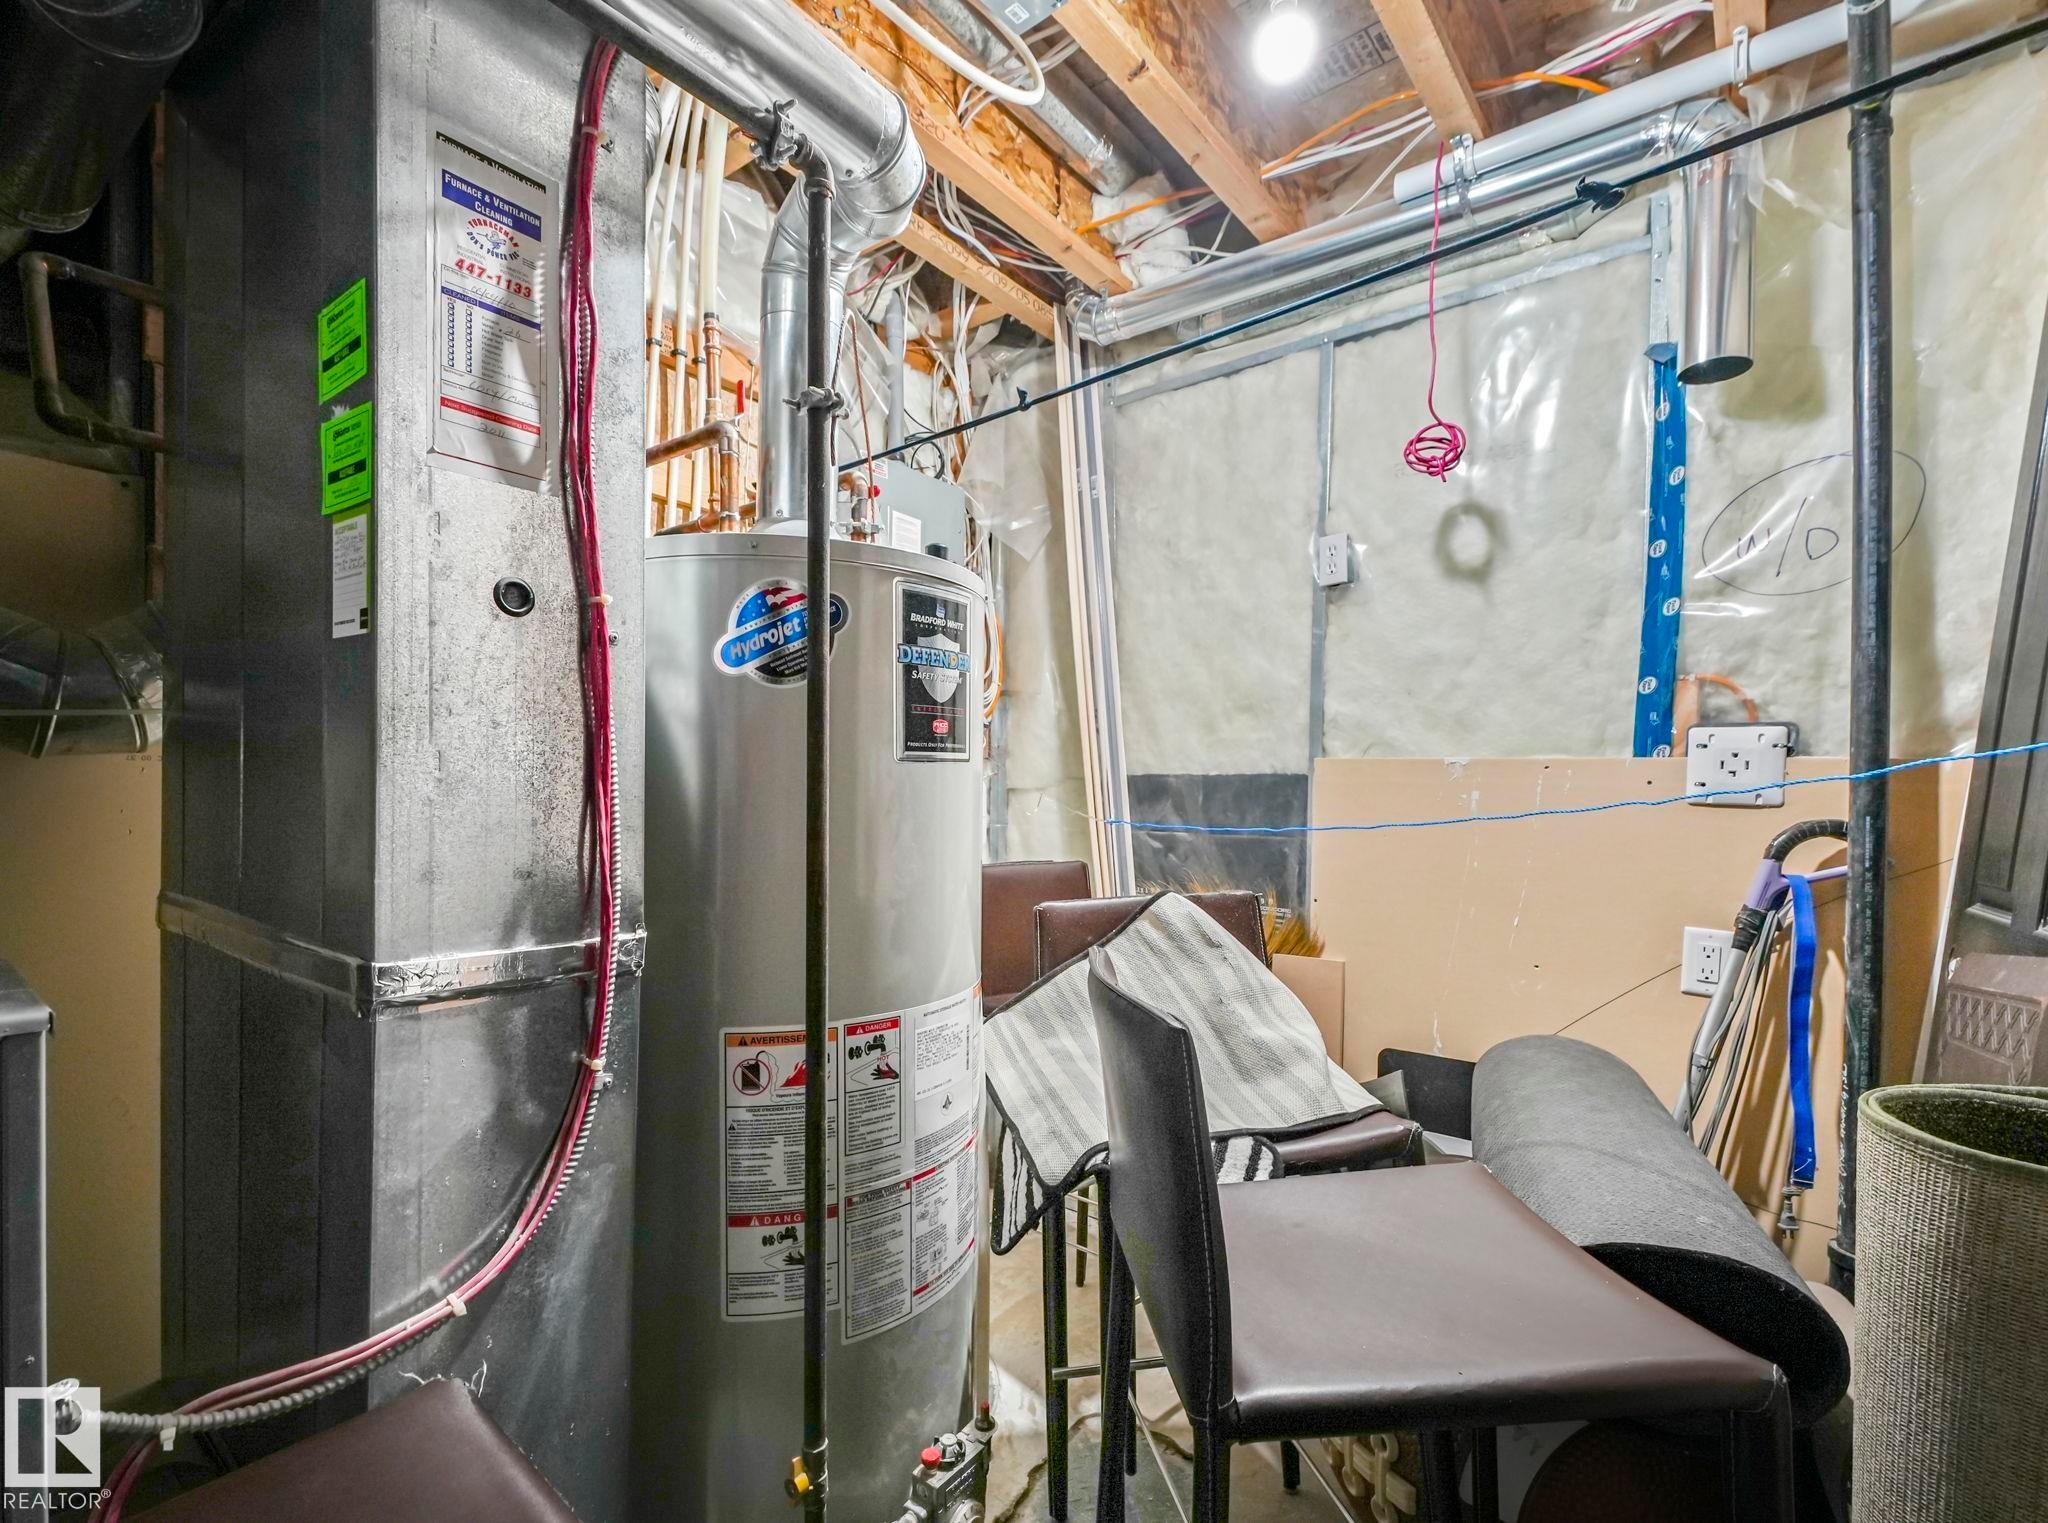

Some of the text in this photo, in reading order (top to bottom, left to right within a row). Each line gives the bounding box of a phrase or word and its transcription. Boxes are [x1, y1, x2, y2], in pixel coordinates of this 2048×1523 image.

[444, 173, 541, 228] FURNACE & VENTILATION
[474, 201, 513, 227] CLEANING
[467, 217, 520, 248] FURNACEMAN
[454, 258, 532, 298] 447-1133
[443, 287, 477, 304] CLEANED
[910, 612, 965, 631] BRADFORD WHITE
[730, 616, 802, 661] Hydrojet
[897, 643, 971, 673] DEFENDER
[911, 670, 939, 681] SAFETY
[865, 1021, 892, 1032] DANGER
[750, 1034, 806, 1045] AVERTISSE
[763, 1214, 802, 1225] DANG
